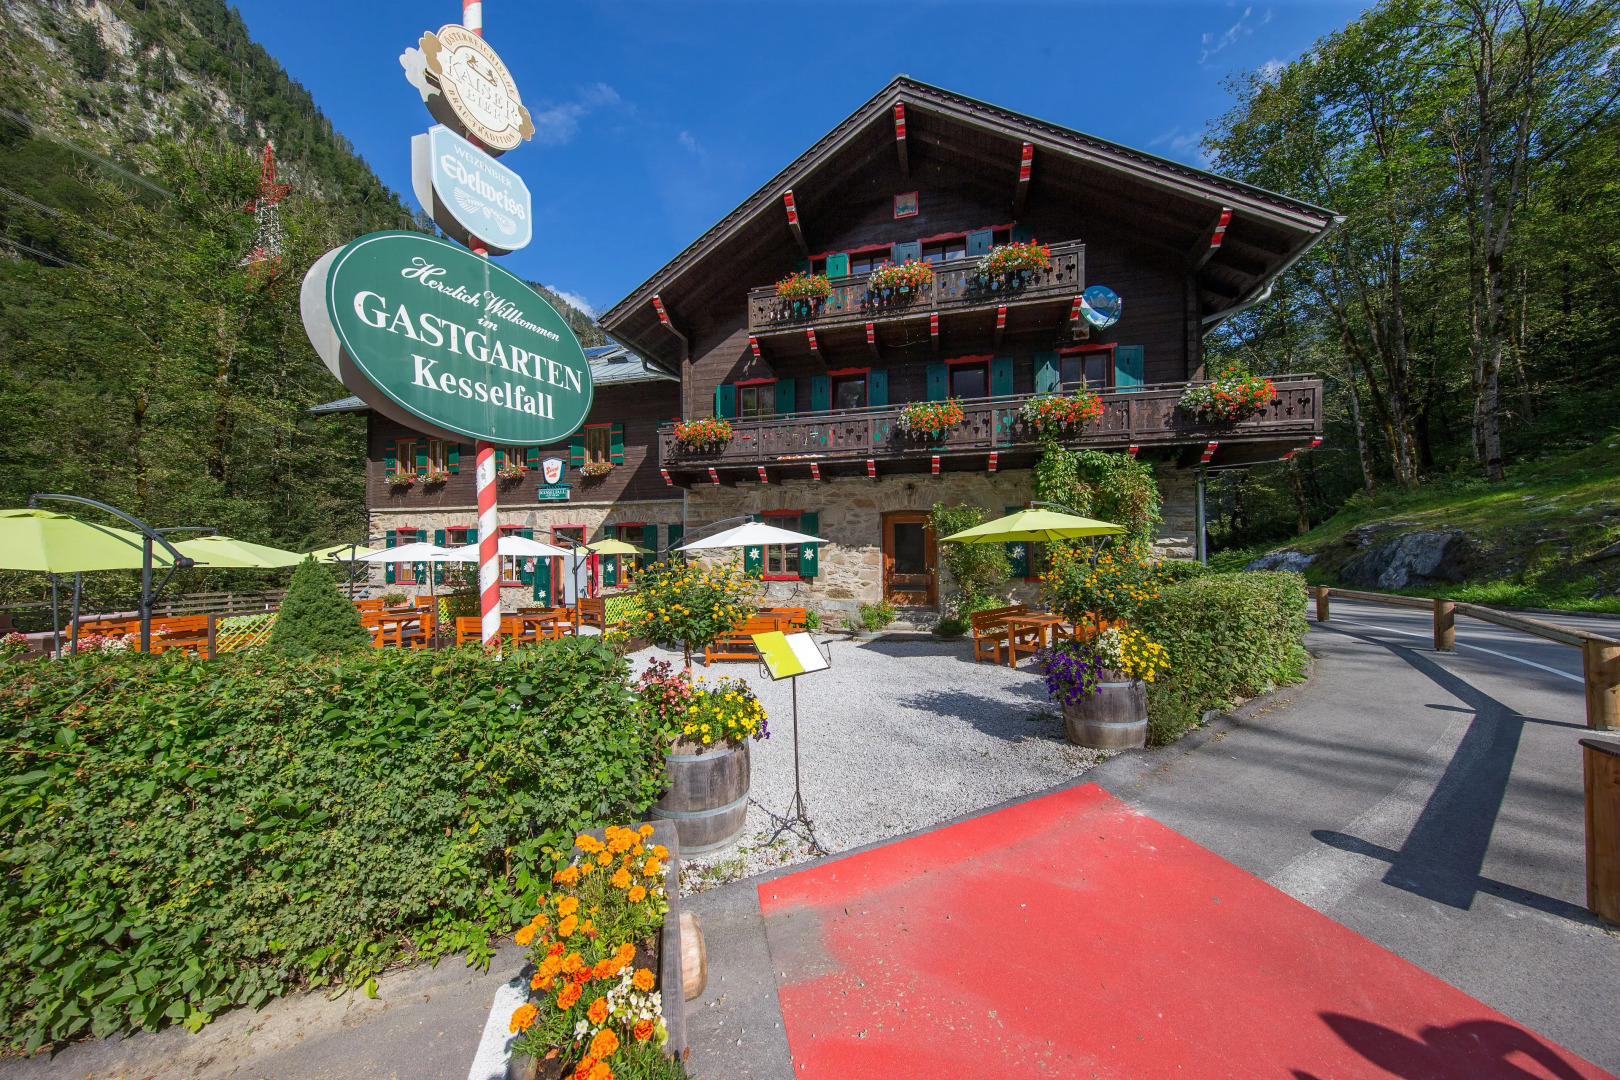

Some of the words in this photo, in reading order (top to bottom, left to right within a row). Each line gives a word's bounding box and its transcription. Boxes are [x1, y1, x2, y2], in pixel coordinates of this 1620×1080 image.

[444, 31, 515, 95] ÖSTERREICHISCHE
[446, 55, 519, 126] KAISER
[448, 89, 516, 144] BRAU-TRADITION
[466, 88, 503, 123] BIER
[441, 153, 526, 220] Edelweiss
[453, 144, 512, 189] WEIZENBIER
[401, 256, 480, 308] Herzlich
[483, 290, 560, 342] Willkommen
[477, 314, 498, 332] im
[353, 290, 583, 394] GASTGARTEN
[411, 353, 555, 420] Kesselfall
